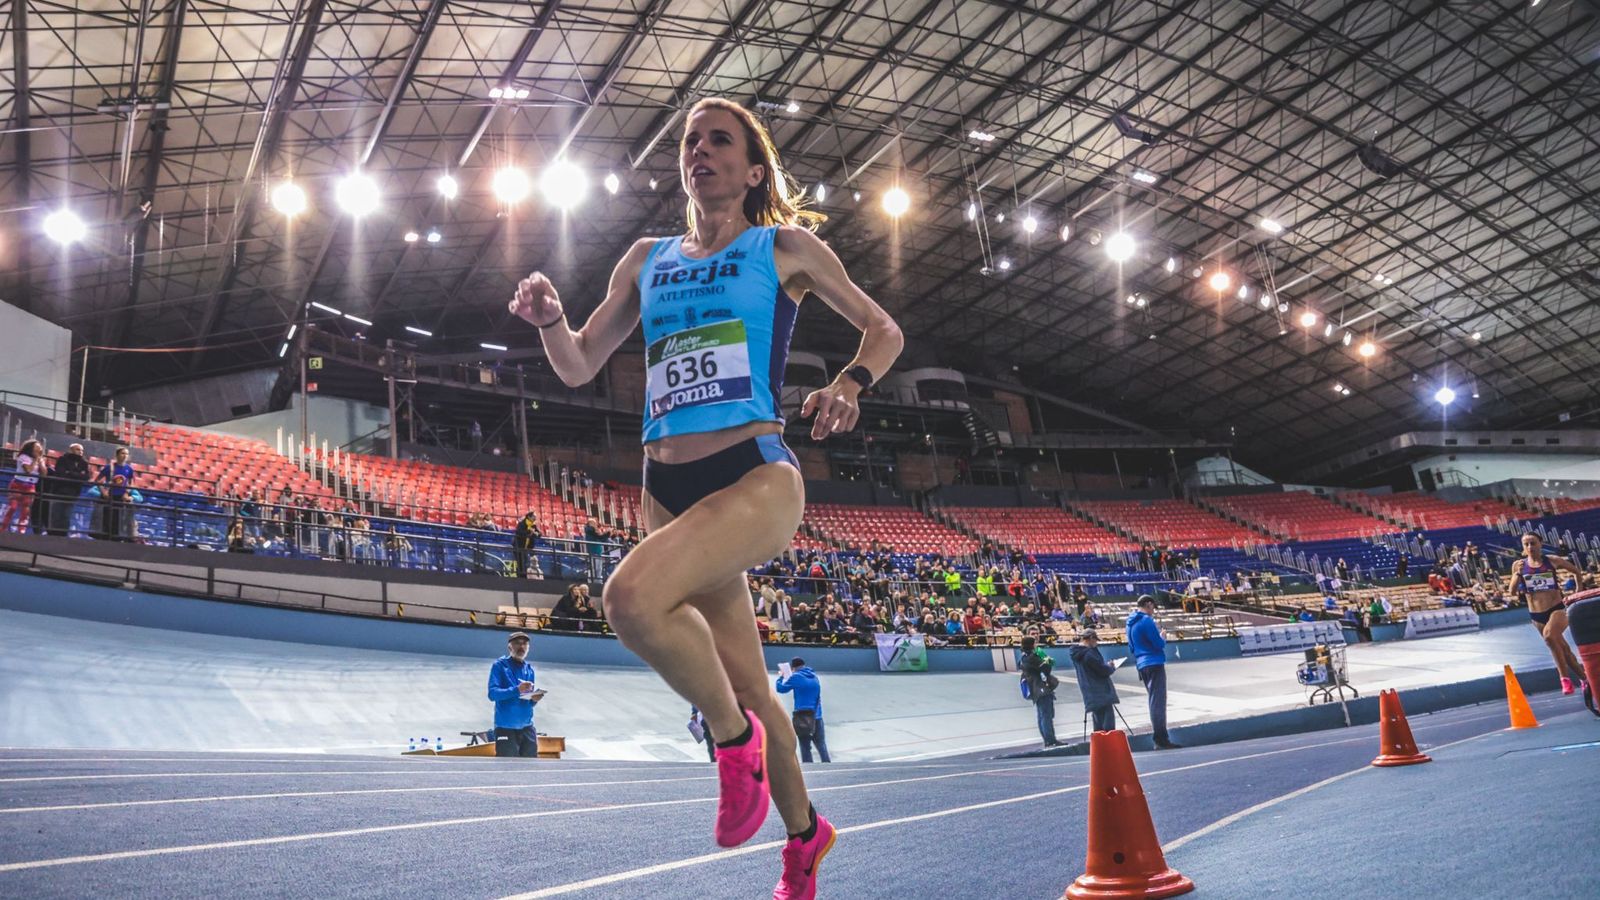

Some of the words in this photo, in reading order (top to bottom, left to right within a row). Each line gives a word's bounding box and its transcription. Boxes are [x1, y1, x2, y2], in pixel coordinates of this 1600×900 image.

[650, 261, 739, 287] nerja
[658, 286, 725, 303] ATLETISMO
[666, 351, 718, 388] 636
